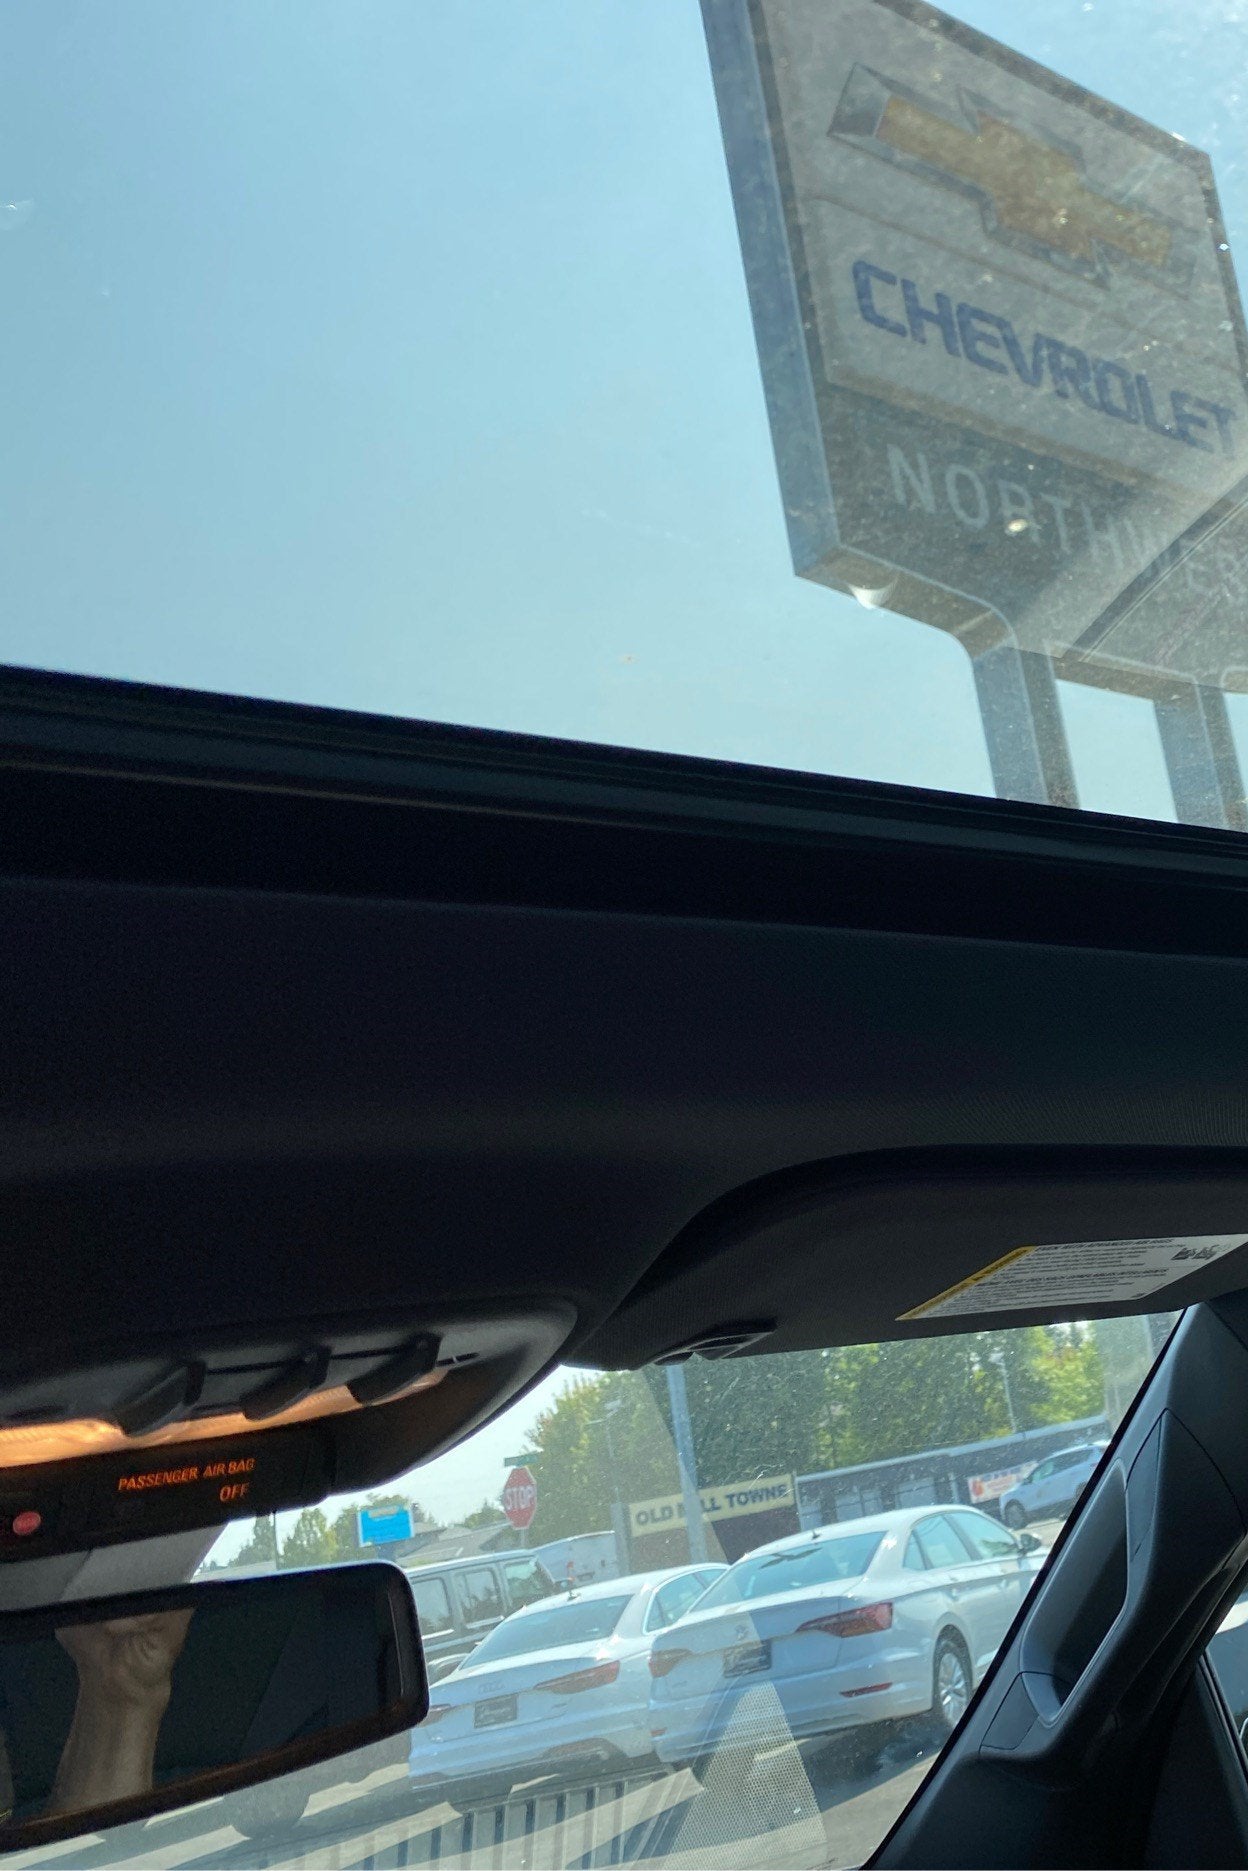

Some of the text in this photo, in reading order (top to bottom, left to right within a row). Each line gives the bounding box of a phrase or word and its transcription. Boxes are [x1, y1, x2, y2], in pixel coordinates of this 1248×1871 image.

[851, 259, 1237, 459] CHEVROLET
[118, 1457, 256, 1491] PASSENGER AIR BAG
[219, 1482, 250, 1502] OFF
[504, 1485, 535, 1510] STOP
[635, 1505, 673, 1526] OLD
[725, 1483, 788, 1509] TOWNE
